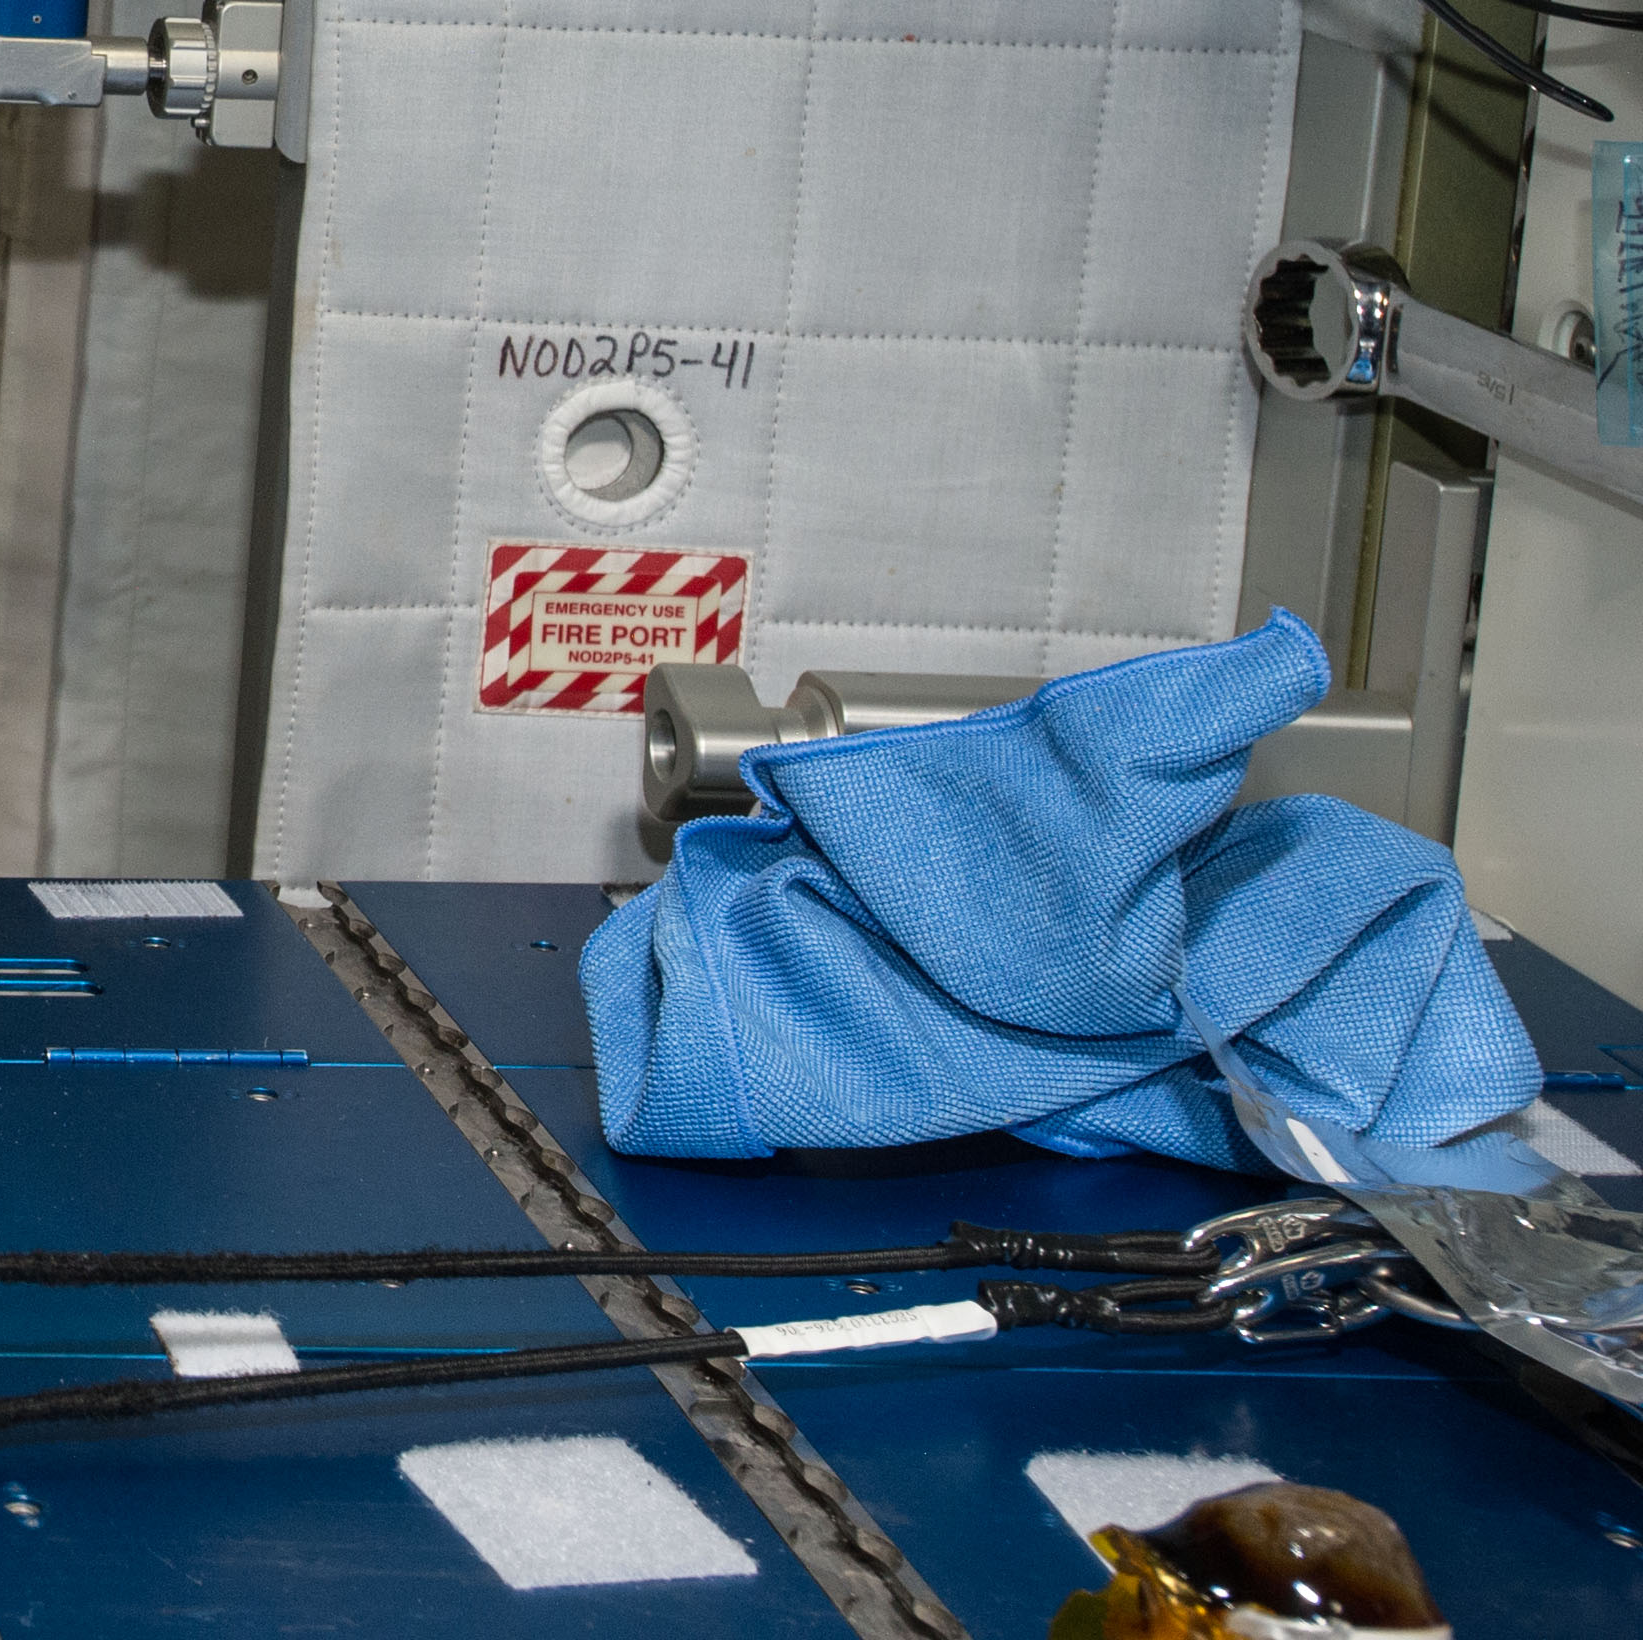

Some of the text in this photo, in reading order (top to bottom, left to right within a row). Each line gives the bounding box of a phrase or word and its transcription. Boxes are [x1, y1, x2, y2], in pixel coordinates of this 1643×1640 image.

[499, 331, 755, 389] NOD2P5-41
[545, 602, 685, 619] EMERGENCY USE
[541, 623, 687, 648] FIRE PORT
[568, 650, 655, 666] NOD2P5-41
